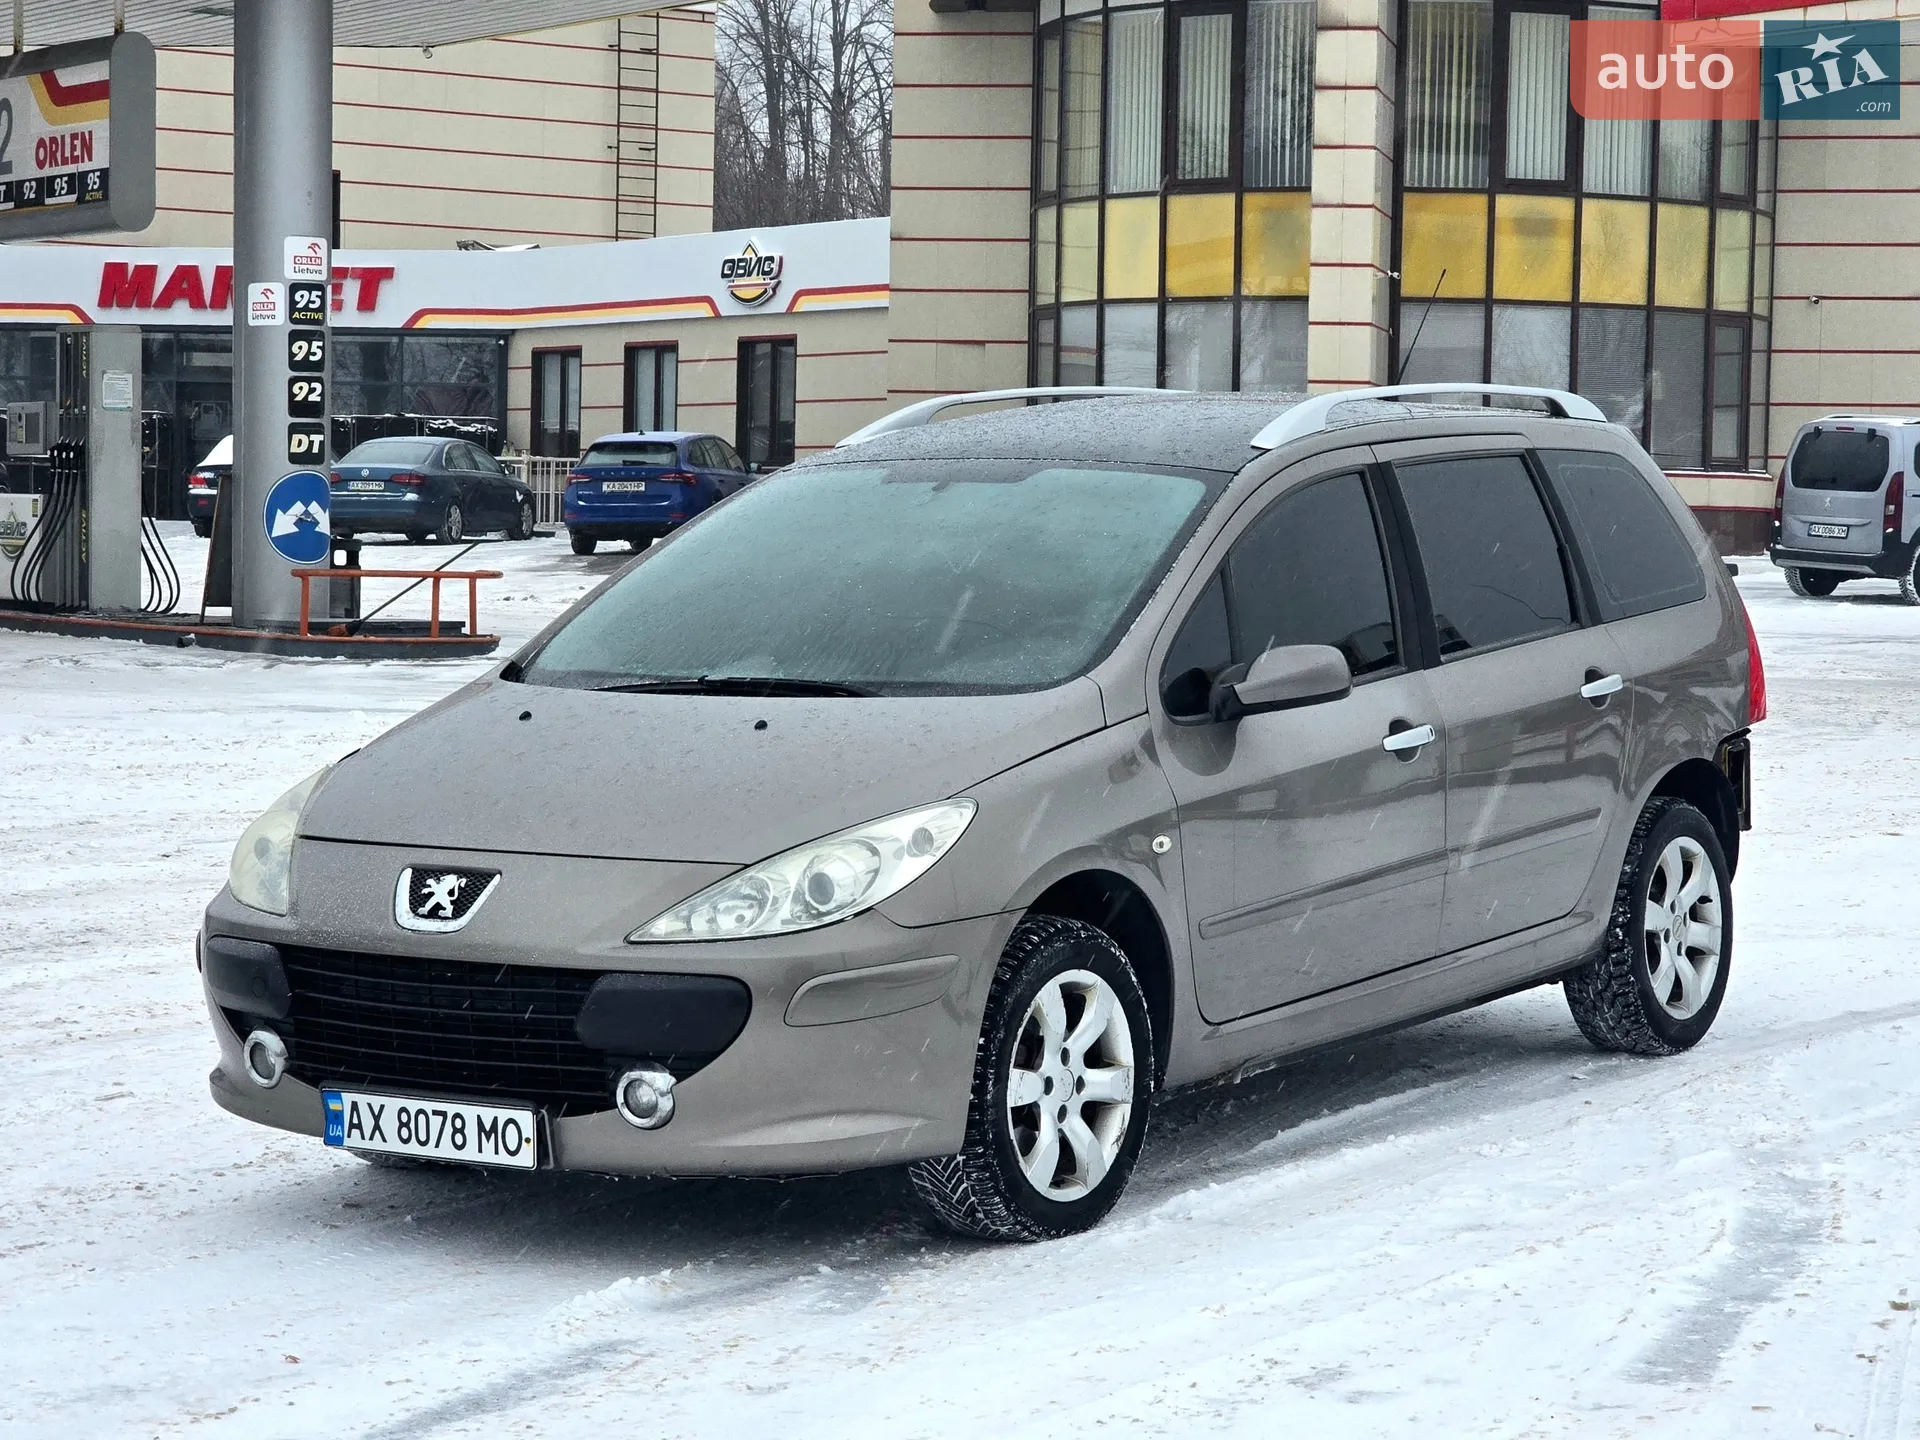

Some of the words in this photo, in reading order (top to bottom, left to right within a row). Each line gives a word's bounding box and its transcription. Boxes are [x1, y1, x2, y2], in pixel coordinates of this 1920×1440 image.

[35, 130, 93, 170] ORLEN
[0, 185, 6, 203] T
[23, 181, 37, 200] 92
[54, 176, 68, 196] 95
[87, 171, 101, 191] 95
[84, 190, 103, 201] ACTIVE
[294, 256, 321, 265] ORLEN
[720, 255, 775, 279] ОВИС
[293, 266, 323, 275] Lietuva
[252, 303, 275, 311] ORLEN
[294, 290, 322, 309] 95
[252, 312, 276, 320] Lietuva
[292, 311, 324, 320] ACTIVE
[291, 340, 324, 361] 95
[292, 381, 323, 402] 92
[289, 433, 324, 453] DT
[1812, 525, 1821, 534] AX
[329, 1124, 343, 1138] UA
[347, 1101, 387, 1143] AX
[397, 1106, 467, 1151] 8078
[477, 1114, 523, 1157] MO
